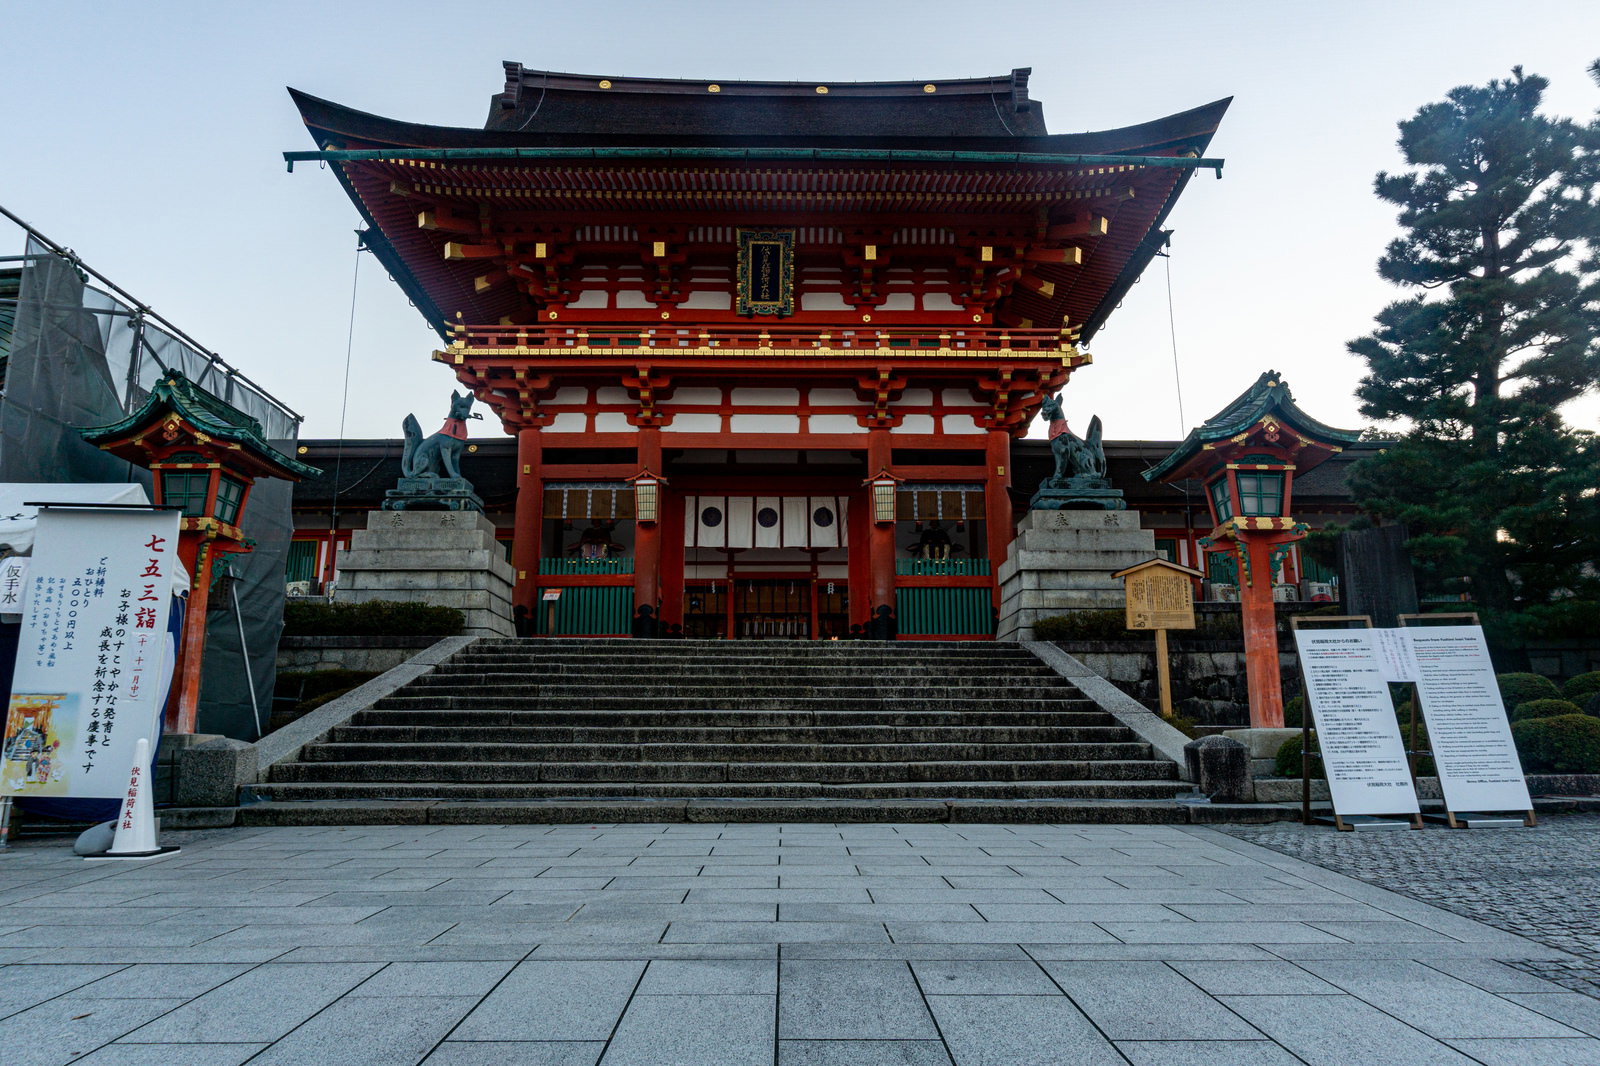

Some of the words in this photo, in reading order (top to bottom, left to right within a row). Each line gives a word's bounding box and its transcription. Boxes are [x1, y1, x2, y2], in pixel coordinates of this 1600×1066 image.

[2, 565, 21, 604] 仮手水
[83, 567, 95, 608] おひとり
[134, 534, 166, 629] 七五三詣
[82, 626, 113, 774] 成長を祈念する慶事です
[101, 588, 131, 747] お子様のすこやかな発育と
[122, 766, 141, 830] 伏見稲荷大社
